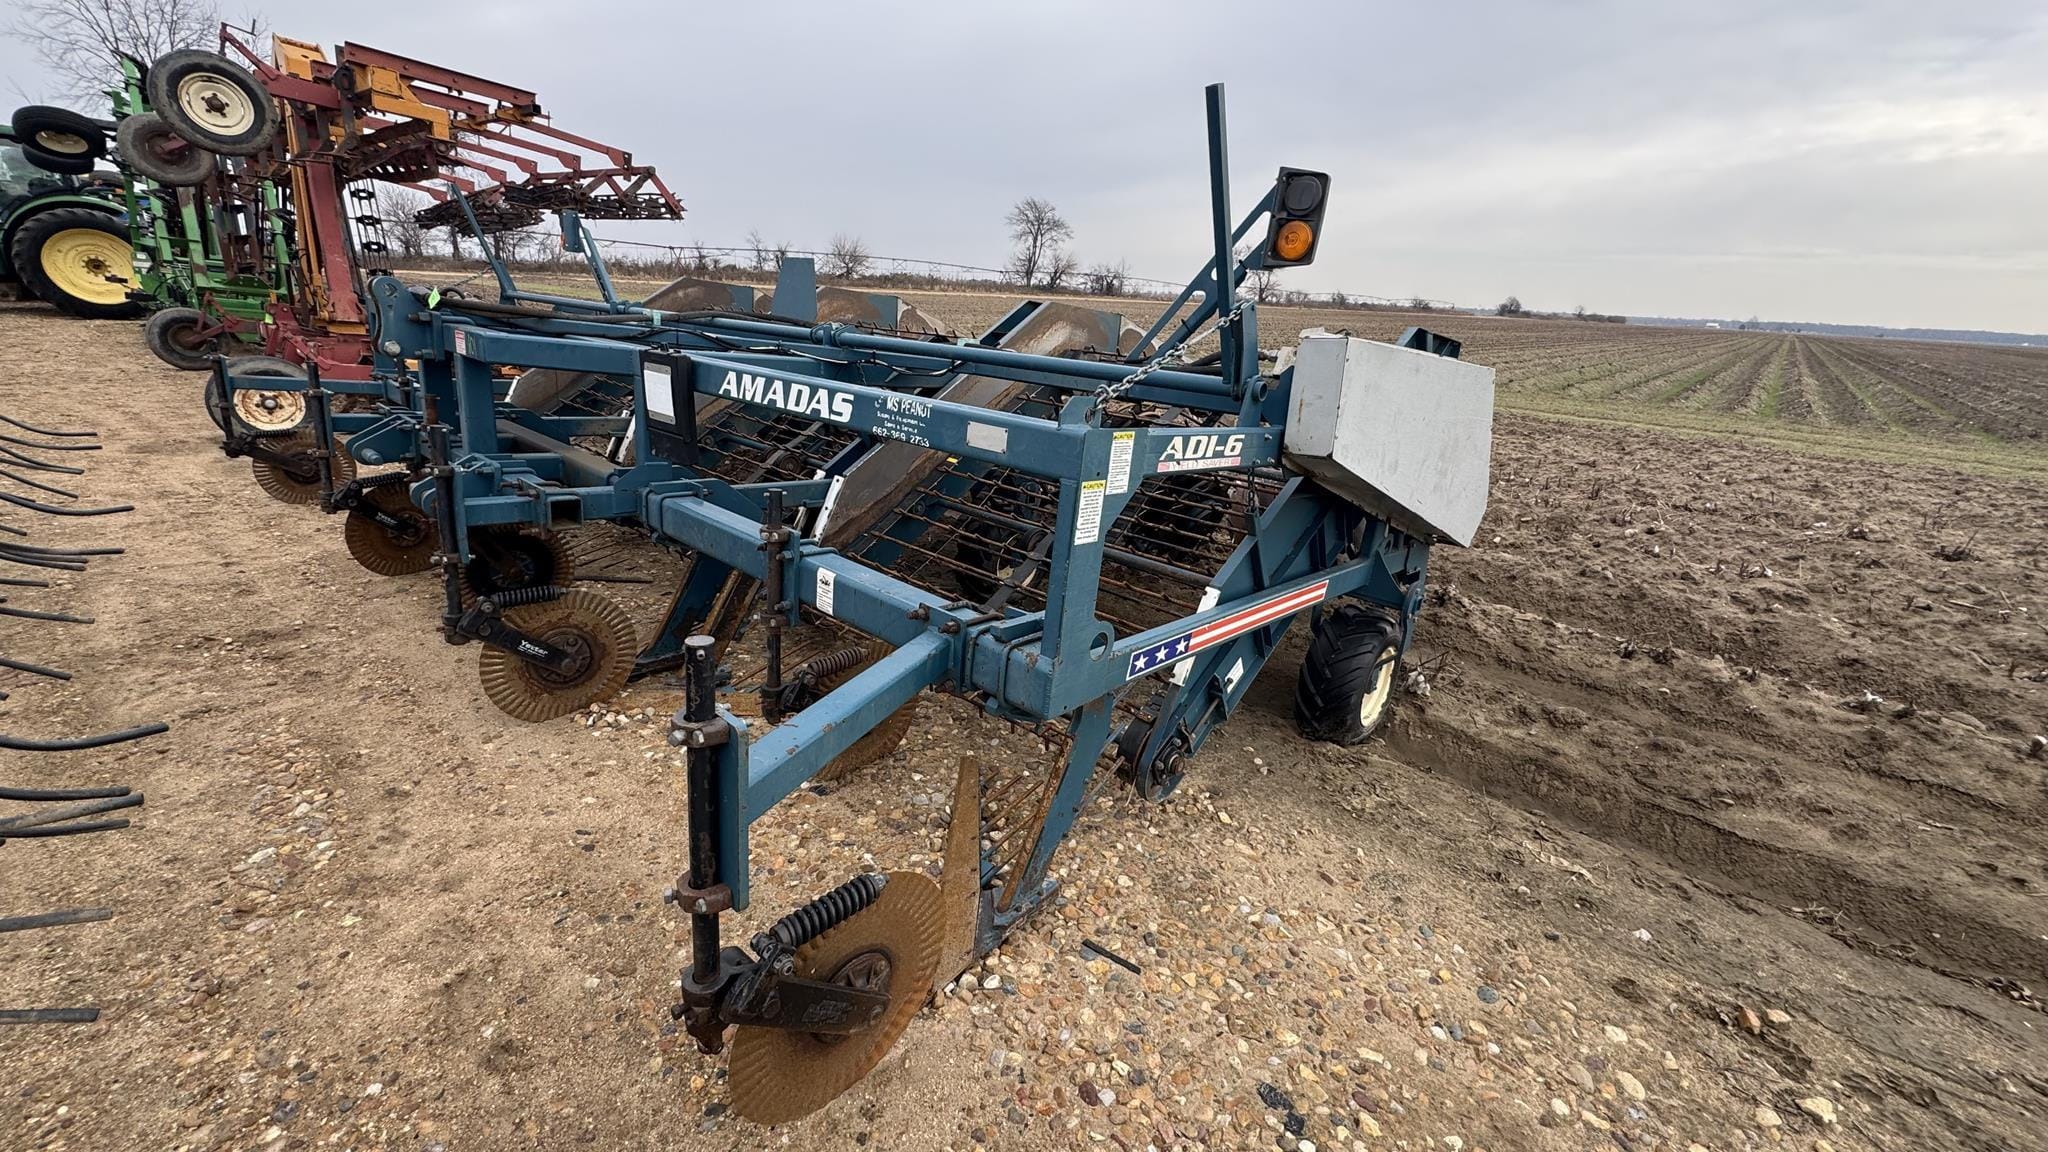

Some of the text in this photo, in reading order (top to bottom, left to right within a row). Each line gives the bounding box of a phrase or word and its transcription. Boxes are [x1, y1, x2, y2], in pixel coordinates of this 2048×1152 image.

[719, 371, 855, 423] AMADAS
[887, 396, 932, 418] MS PEANUT
[1159, 434, 1246, 461] ADI-6
